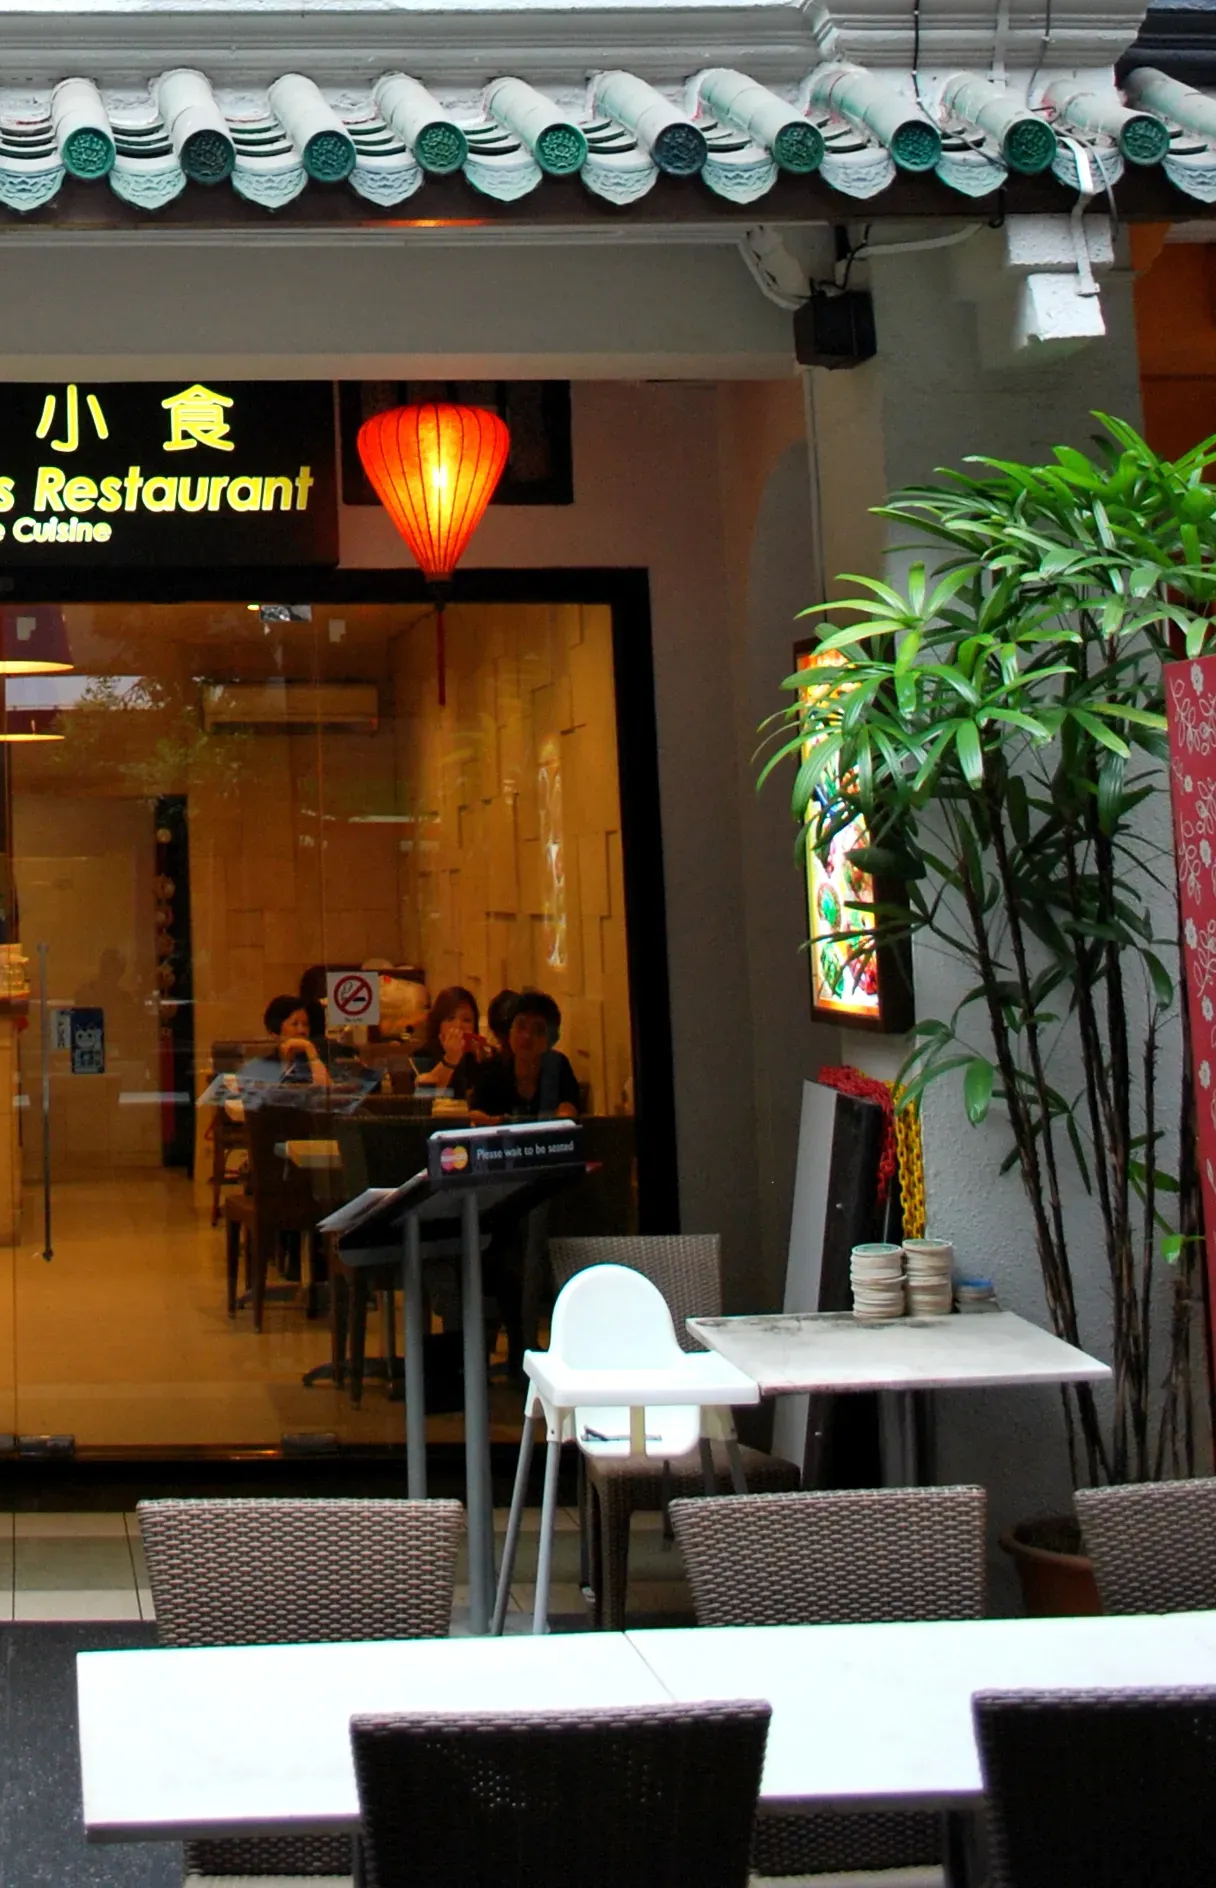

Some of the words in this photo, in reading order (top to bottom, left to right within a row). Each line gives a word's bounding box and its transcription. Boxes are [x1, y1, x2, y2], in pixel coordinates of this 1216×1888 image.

[34, 465, 314, 512] Restaurant
[12, 516, 112, 543] Cuisine
[476, 1146, 503, 1160] Please
[504, 1145, 523, 1157] wait
[524, 1145, 534, 1155] to
[535, 1142, 546, 1154] be
[548, 1140, 574, 1153] seated
